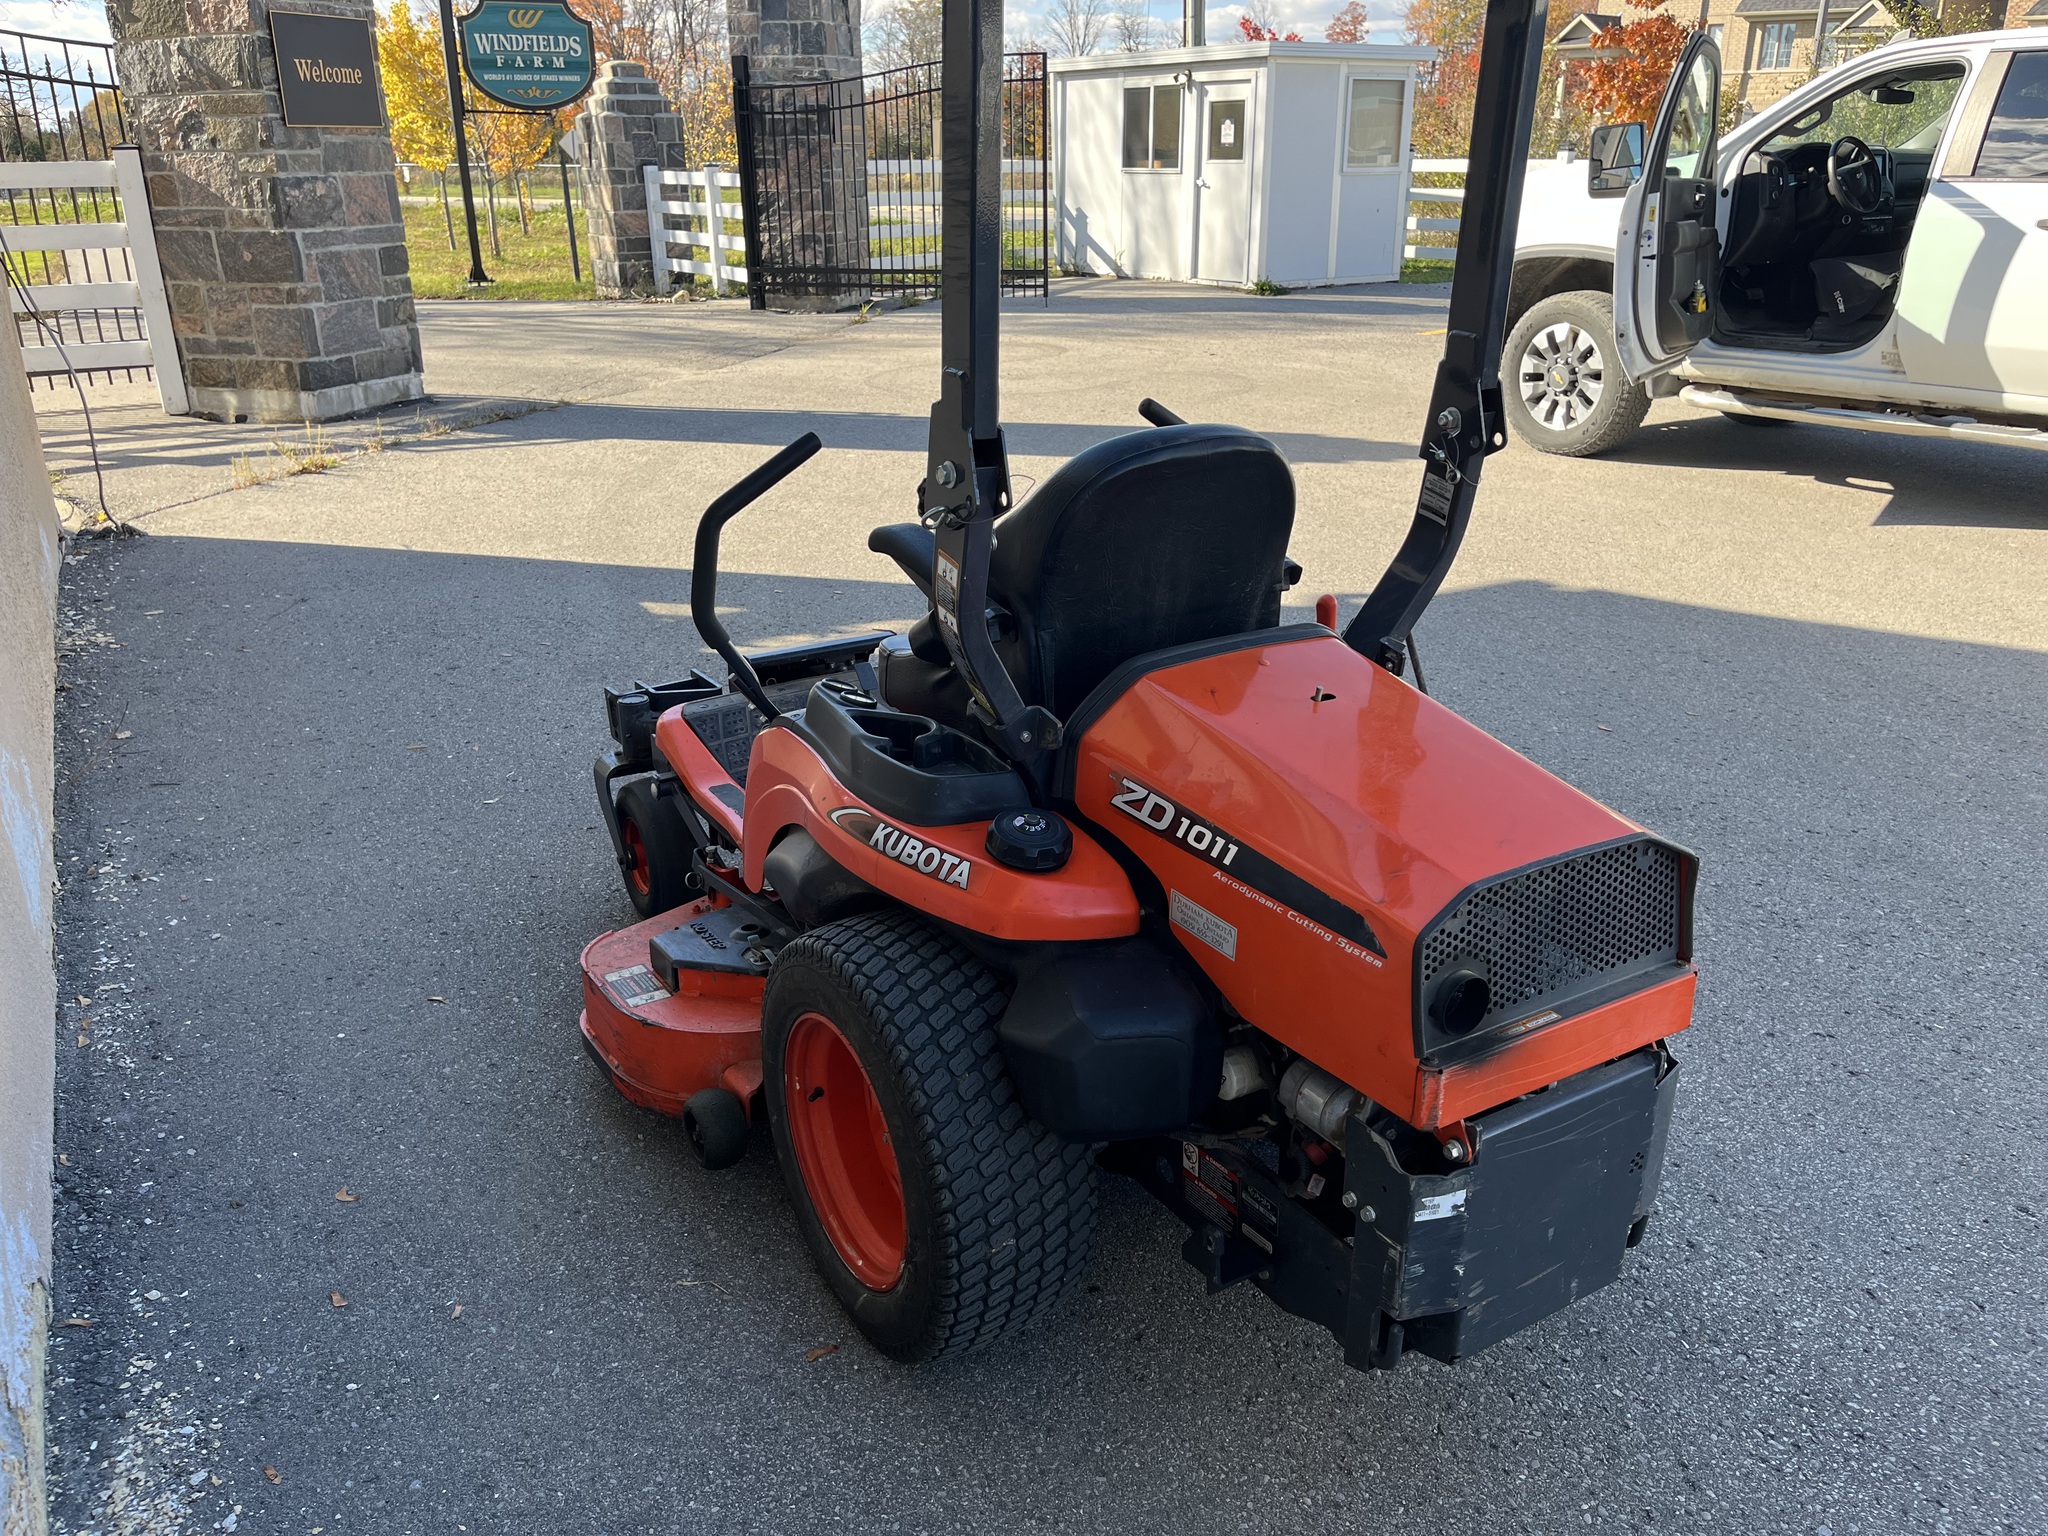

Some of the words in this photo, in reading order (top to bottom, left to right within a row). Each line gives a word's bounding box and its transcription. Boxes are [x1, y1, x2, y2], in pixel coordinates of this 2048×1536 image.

[474, 33, 582, 57] WINDFIELDS
[293, 58, 363, 84] Welcome
[483, 73, 506, 81] WORLD'S
[541, 74, 558, 82] STAKES
[1110, 777, 1176, 831] ZD
[1175, 816, 1239, 866] 1011
[868, 822, 972, 890] KUBOTA
[1212, 870, 1284, 914] Aerodynamic
[1286, 911, 1333, 942] Cutting
[1335, 937, 1383, 968] System
[701, 932, 727, 949] STEP
